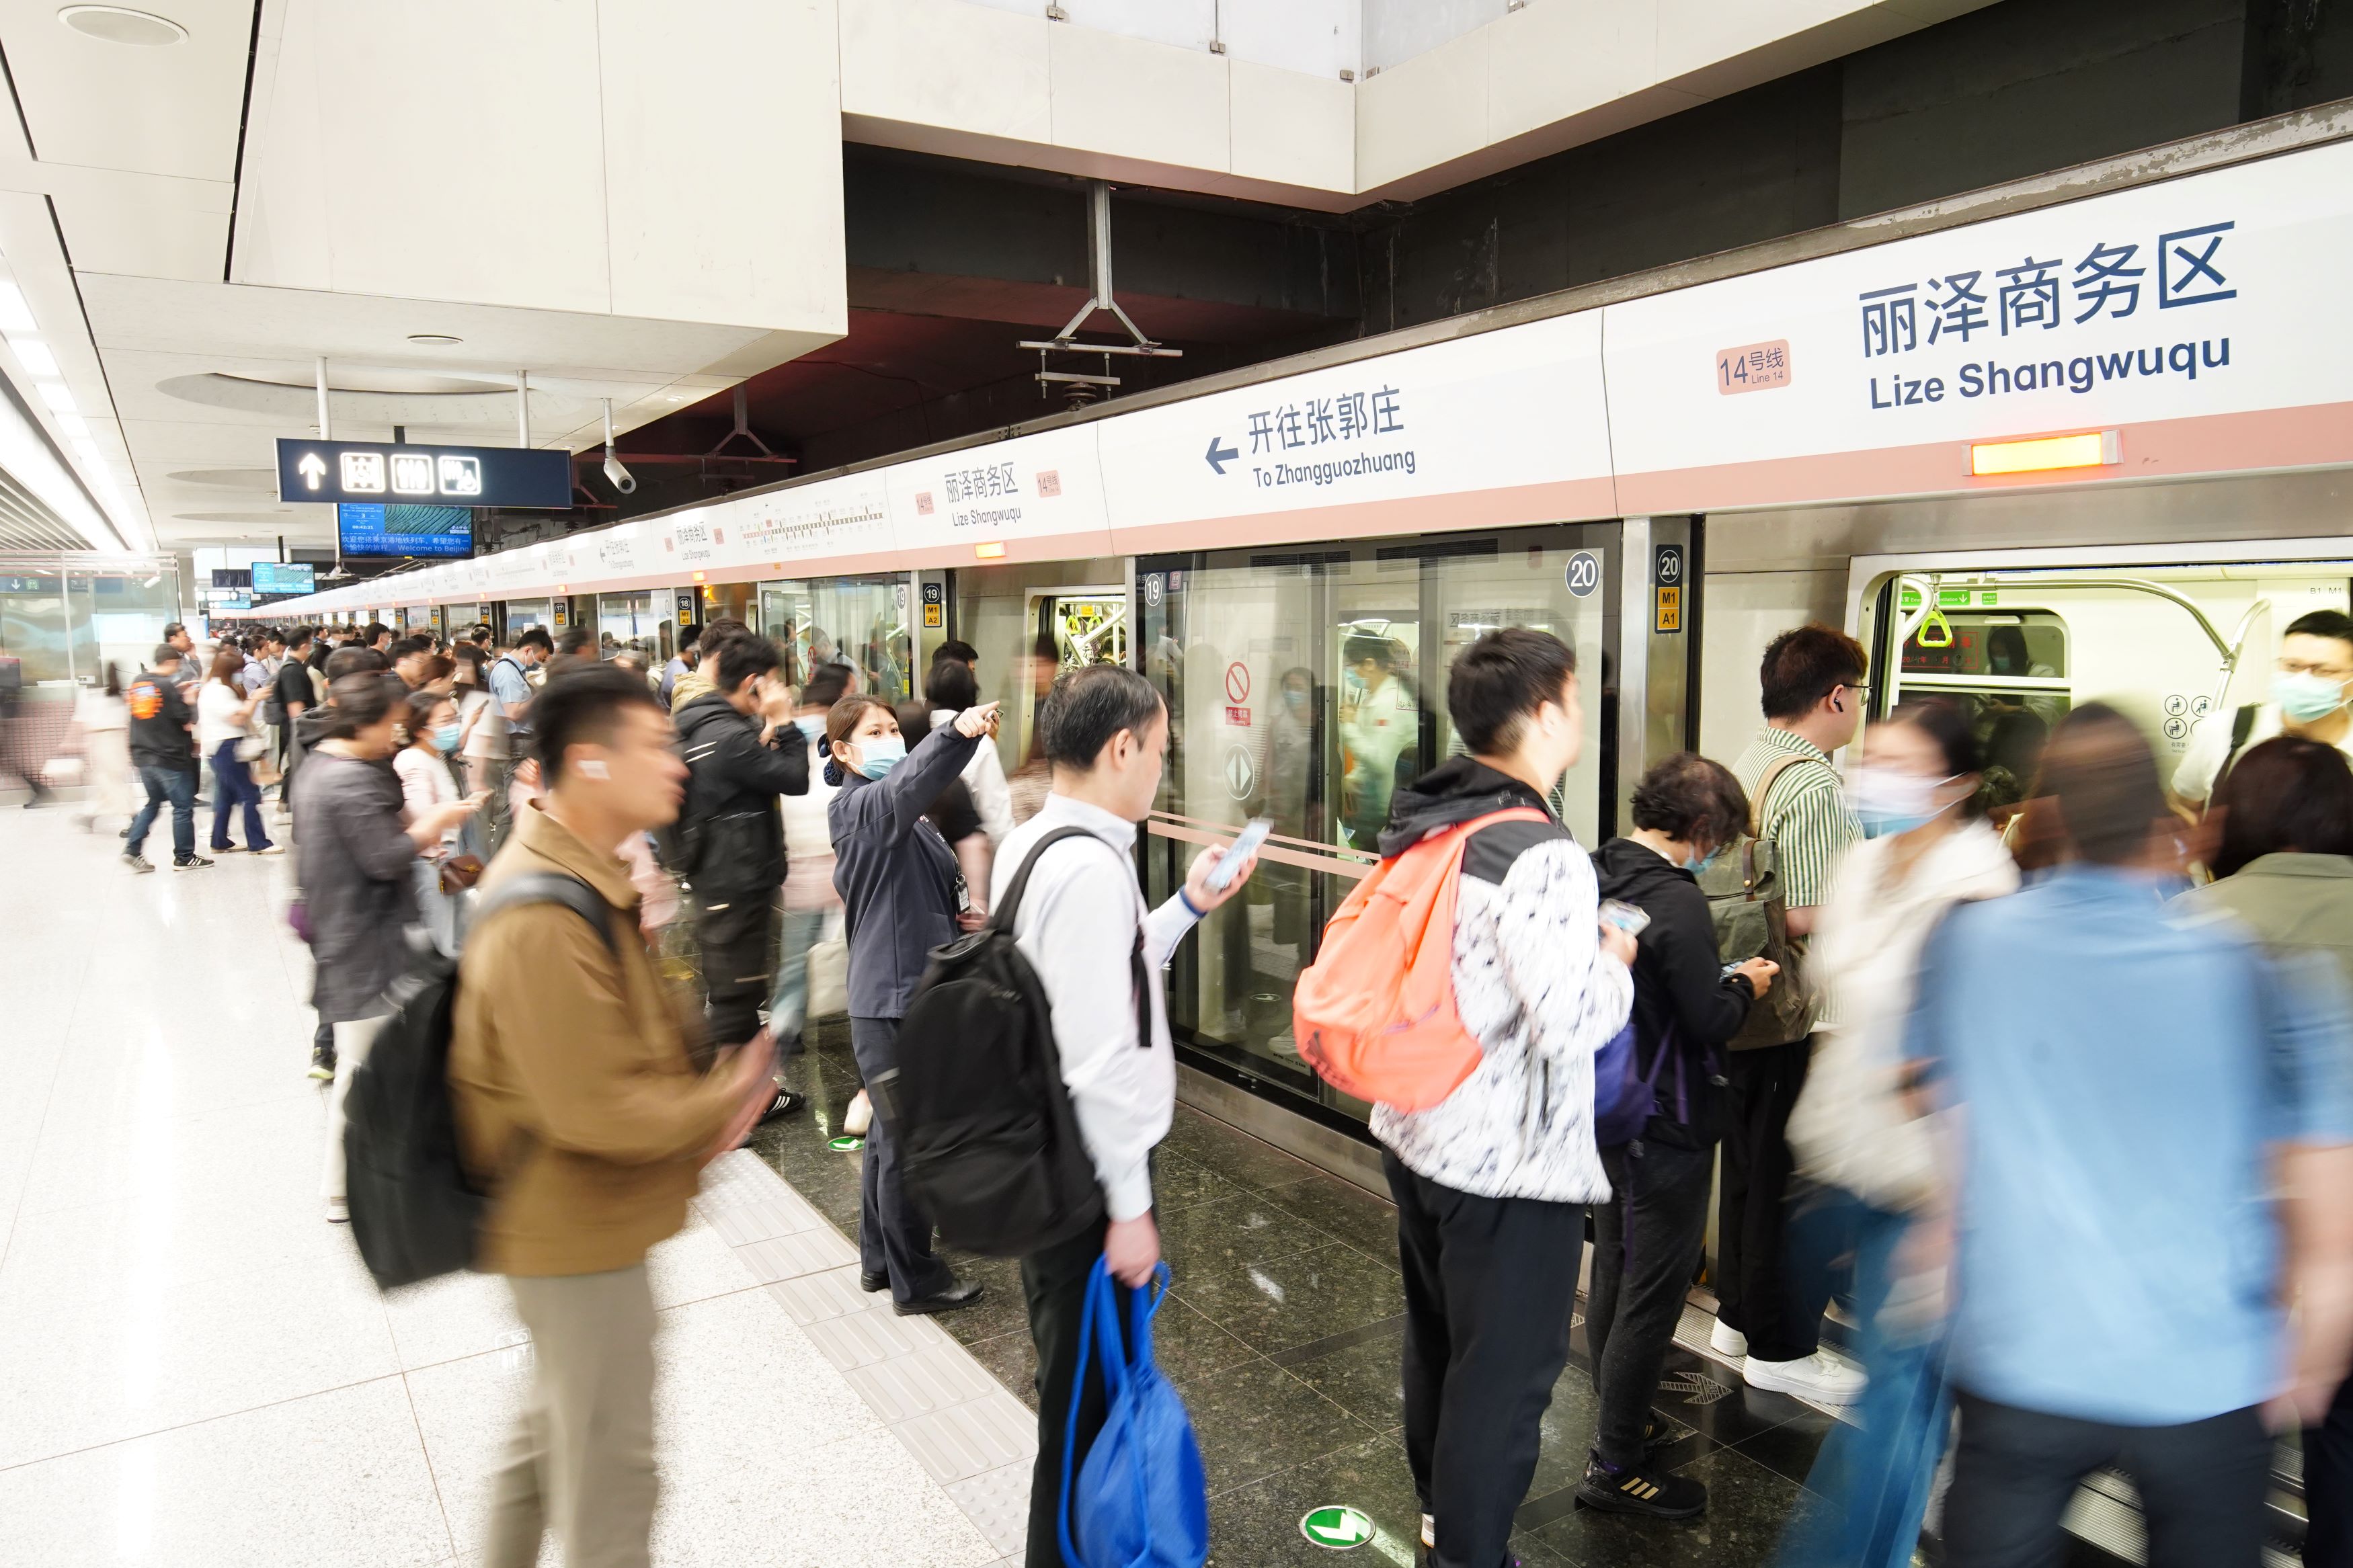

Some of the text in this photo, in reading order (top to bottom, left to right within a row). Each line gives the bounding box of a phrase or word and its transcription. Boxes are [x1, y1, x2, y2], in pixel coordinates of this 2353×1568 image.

[1859, 220, 2237, 358] 丽泽商务区
[1720, 347, 1784, 386] 14号线
[1870, 337, 2230, 409] Lize Shangwuqu
[1751, 371, 1783, 384] Line 14
[1248, 384, 1404, 454] 开往张郭庄
[1253, 450, 1416, 488] To Zhangguozhuang
[945, 461, 1019, 503] 丽泽商务区
[952, 507, 1021, 527] Lize Shangwuqu
[1570, 560, 1595, 587] 20
[1661, 556, 1679, 576] 20
[898, 591, 906, 606] 19
[926, 589, 938, 599] 19
[1147, 580, 1159, 600] 19
[1662, 591, 1675, 604] M1
[2328, 587, 2342, 595] M1
[1663, 612, 1675, 624] A1
